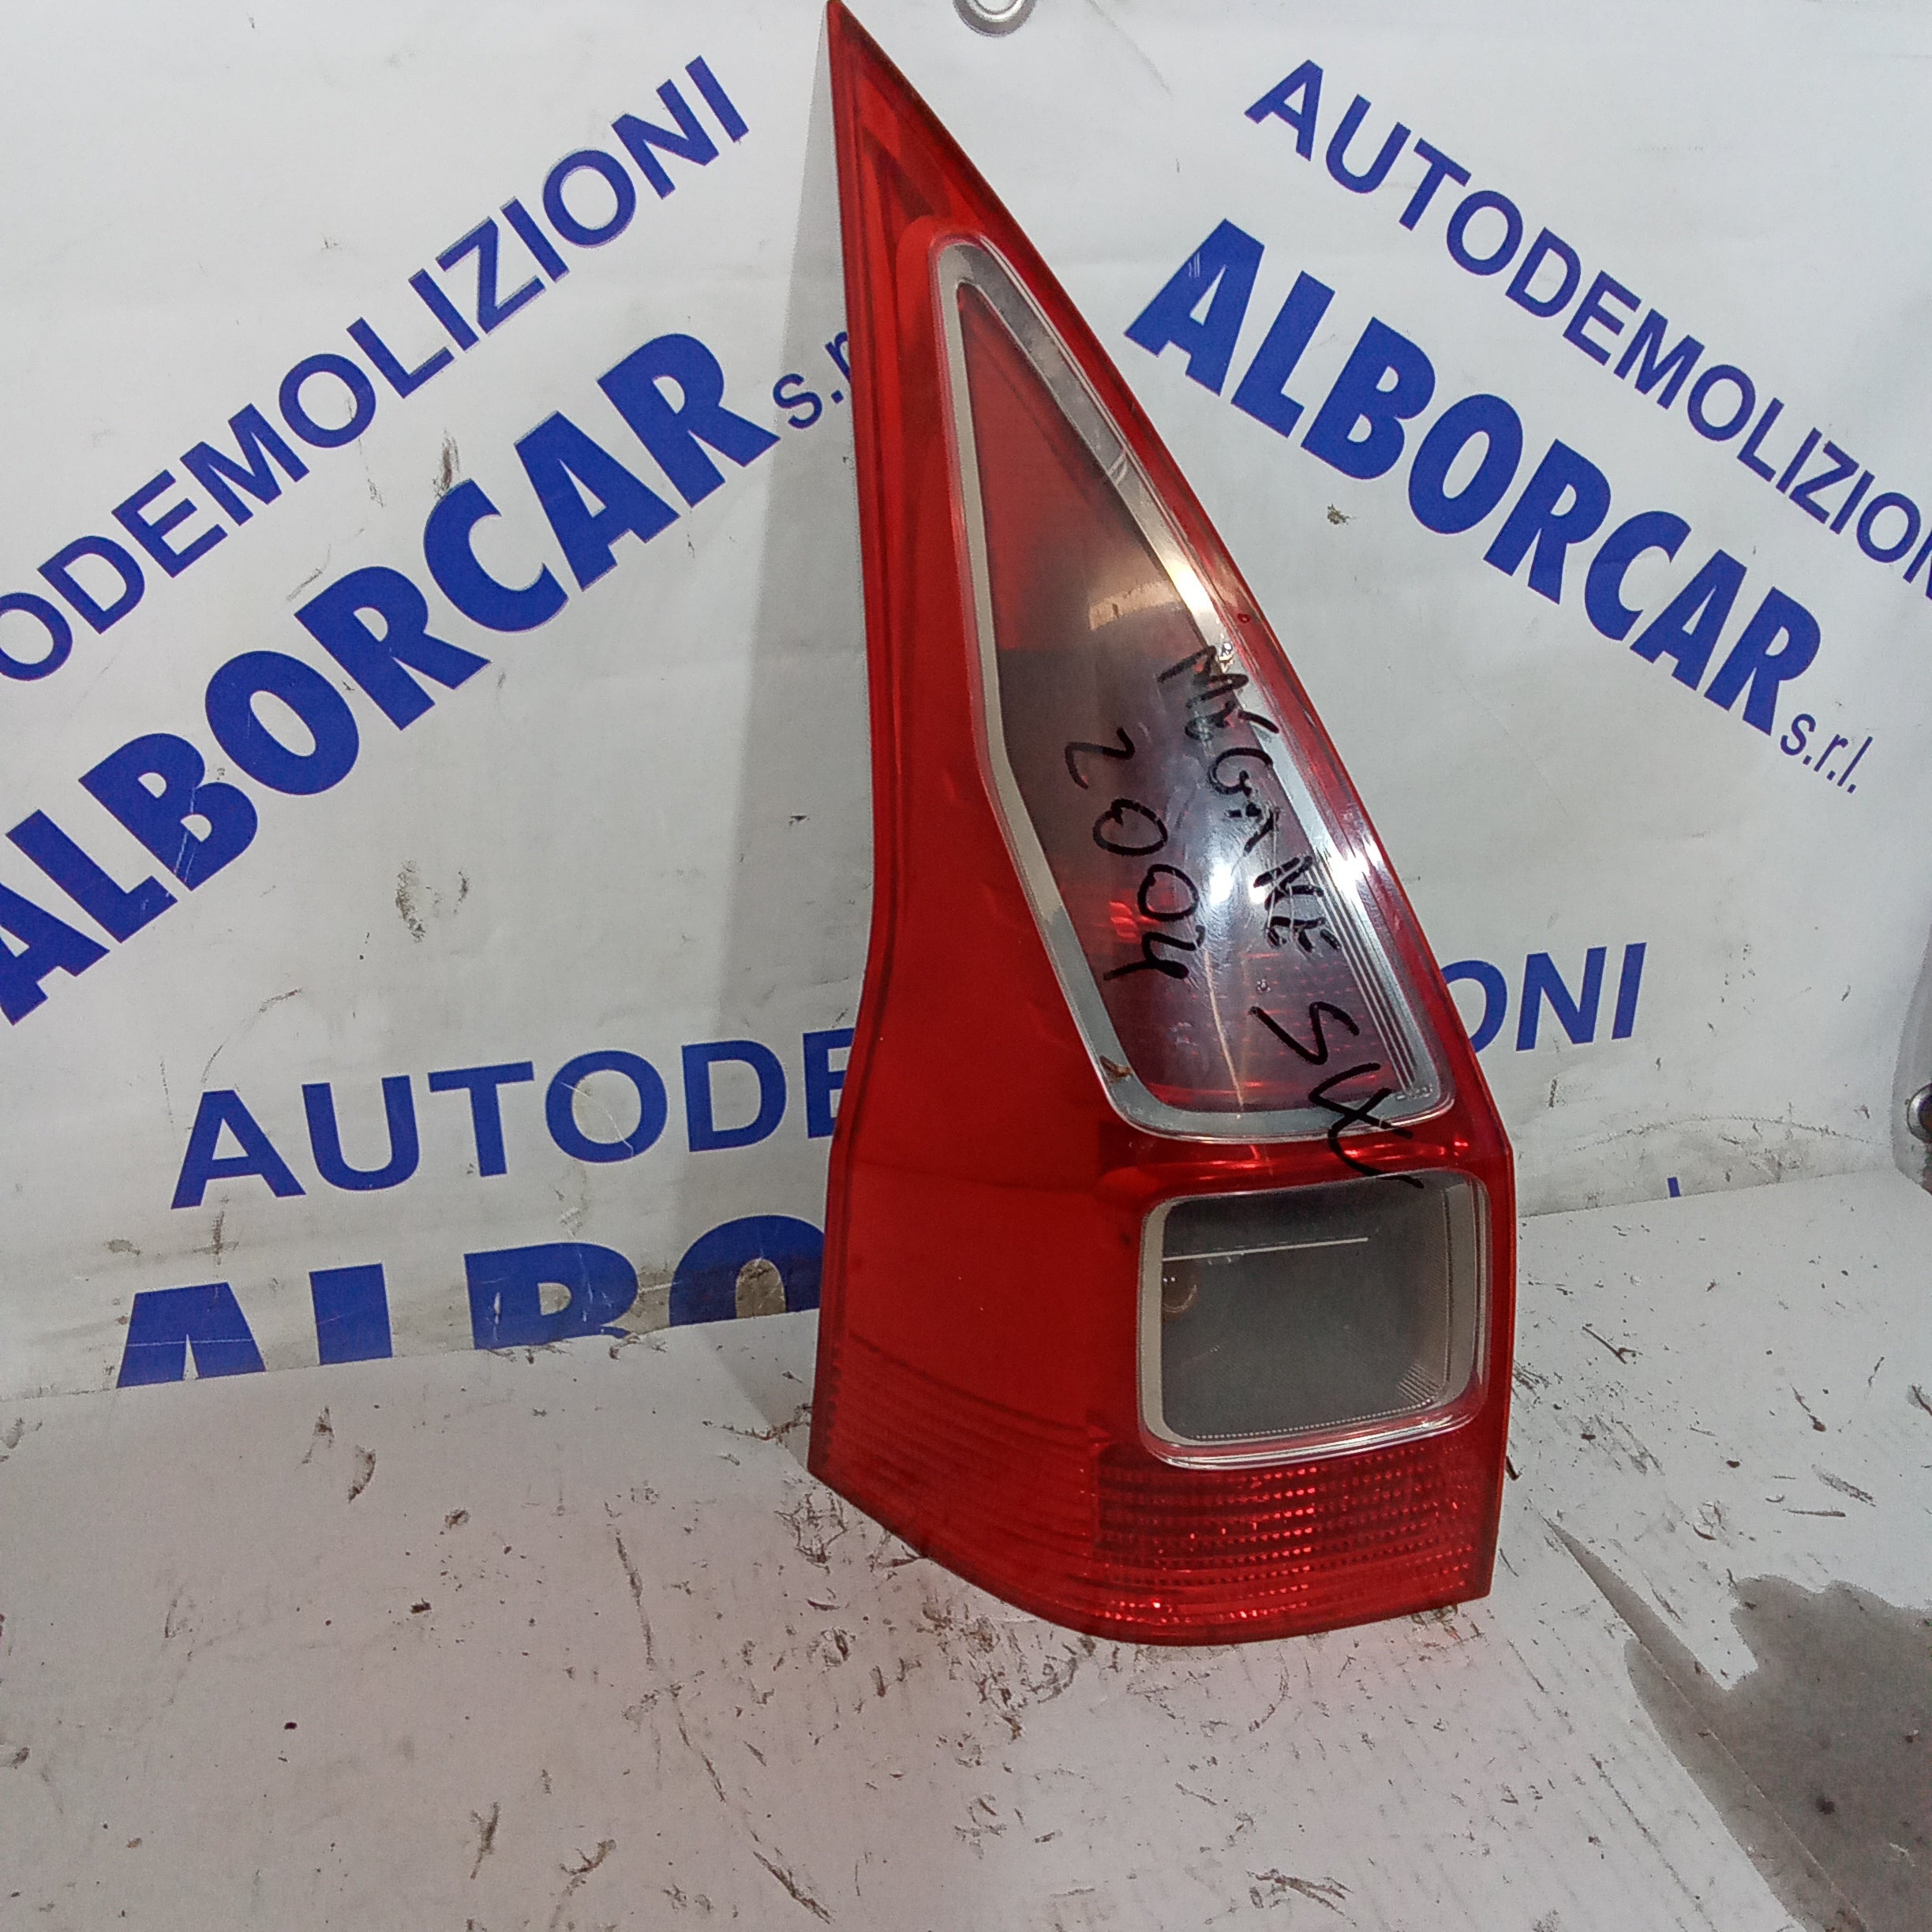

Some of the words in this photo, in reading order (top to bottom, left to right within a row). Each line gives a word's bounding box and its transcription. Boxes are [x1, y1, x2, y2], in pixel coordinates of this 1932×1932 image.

[0, 332, 781, 1026] ALBORCAR
[1124, 218, 1822, 736] ALBORCAR
[1780, 713, 1874, 794] s.r.l.
[1065, 728, 1206, 981] 2004
